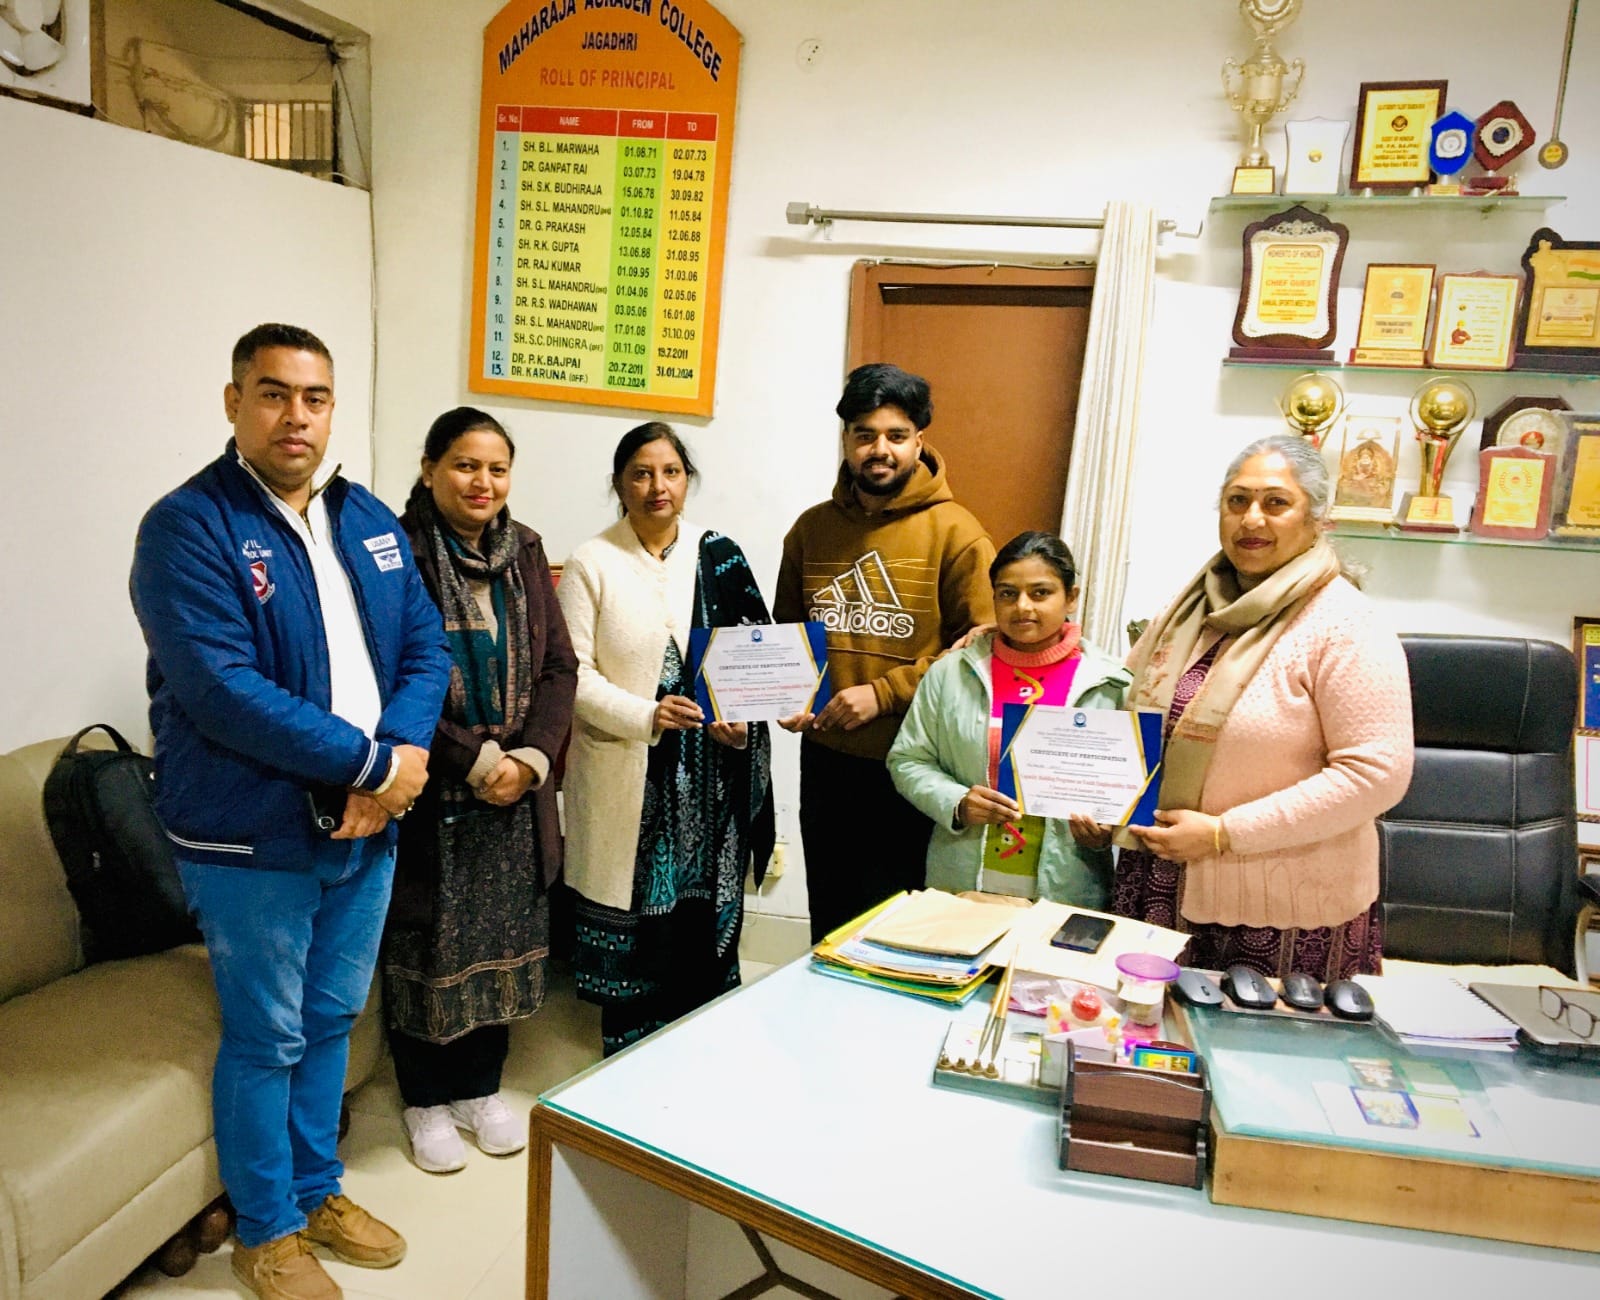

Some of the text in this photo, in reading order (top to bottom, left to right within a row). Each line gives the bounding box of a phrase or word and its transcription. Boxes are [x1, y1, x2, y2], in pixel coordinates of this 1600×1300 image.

[498, 0, 577, 75] MAHARAJA
[582, 32, 638, 51] JAGADHRI
[660, 0, 722, 82] COLLEGE
[541, 67, 675, 90] ROLL OF PRINCIPAL
[560, 116, 580, 126] NAME
[632, 119, 654, 129] FROM
[687, 121, 698, 132] TO
[523, 141, 536, 152] SH.
[539, 142, 554, 153] B.L.
[556, 143, 600, 155] MARWAHA
[624, 146, 657, 158] 01.08.71
[673, 148, 707, 161] 02.07.73
[522, 161, 536, 172] DR.
[538, 161, 572, 174] GANPAT
[573, 163, 588, 175] RAI
[623, 167, 656, 179] 03.07.73
[672, 169, 705, 182] 19.04.78
[521, 181, 535, 192] SH.
[537, 181, 552, 193] S.K.
[554, 182, 603, 195] BUDHIRAJA
[622, 187, 655, 199] 15.06.78
[670, 189, 704, 202] 30.09.82
[520, 200, 534, 211] SH.
[535, 201, 550, 212] S.L.
[620, 206, 653, 219] 01.10.82
[669, 210, 702, 222] 11.05.84
[519, 219, 533, 230] DR.
[535, 220, 544, 232] G.
[545, 221, 586, 234] PRAKASH
[620, 226, 652, 239] 12.05.84
[668, 229, 701, 242] 12.06.88
[518, 239, 532, 250] SH.
[533, 240, 550, 252] R.K.
[552, 241, 580, 253] GUPTA
[619, 246, 651, 259] 13.06.88
[666, 249, 700, 262] 31.08.95
[517, 258, 531, 269] DR.
[533, 259, 549, 271] RAJ
[551, 260, 581, 273] KUMAR
[617, 265, 650, 278] 01.09.95
[665, 269, 698, 282] 31.03.06
[516, 277, 530, 288] SH.
[532, 278, 547, 289] S.L.
[616, 285, 648, 298] 01.04.06
[663, 289, 697, 302] 02.05.06
[515, 296, 529, 307] DR.
[531, 297, 547, 309] R.S.
[549, 299, 598, 312] WADHAWAN
[614, 304, 647, 317] 03.05.06
[663, 308, 695, 321] 16.01.08
[514, 314, 528, 326] SH.
[530, 316, 544, 327] S.L.
[615, 324, 646, 336] 17.01.08
[513, 332, 528, 344] SH.
[613, 342, 646, 355] 01.11.09
[492, 350, 503, 361] 12.
[512, 352, 526, 363] DR.
[608, 361, 643, 374] 20.7.2011
[656, 366, 694, 379] 31.01.2024
[511, 365, 525, 376] DR.
[526, 367, 567, 381] KARUNA
[607, 375, 646, 388] 01.02.2024
[808, 601, 915, 638] adidas
